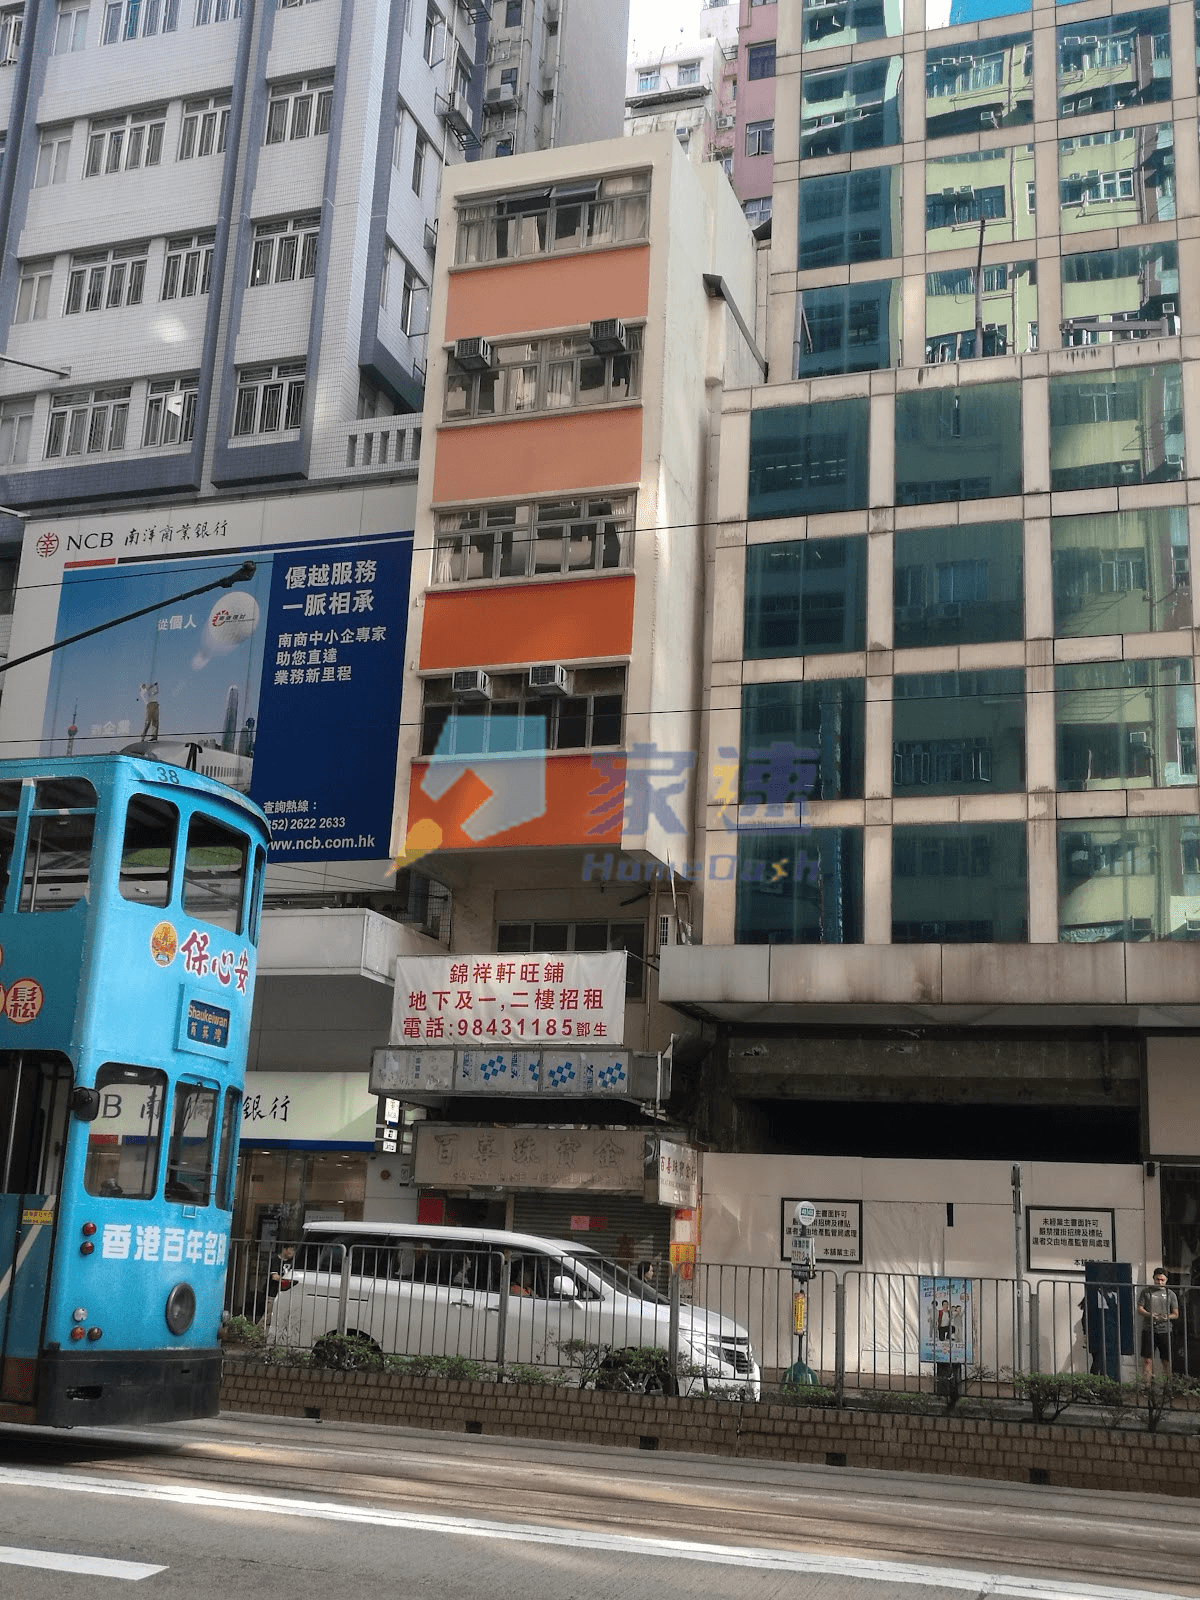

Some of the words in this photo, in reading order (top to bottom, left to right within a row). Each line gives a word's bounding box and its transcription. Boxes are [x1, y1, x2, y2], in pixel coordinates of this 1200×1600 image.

[66, 532, 114, 551] NCB
[124, 519, 229, 546] 南洋商業銀行
[285, 559, 377, 590] 優越服務
[282, 589, 375, 617] 一脈相承
[158, 614, 197, 631] 從個人
[278, 625, 387, 648] 南商中小企專家
[275, 648, 338, 667] 助您直達
[274, 665, 352, 686] 業務新里程
[157, 766, 180, 785] 38
[290, 818, 317, 830] 2622
[319, 816, 346, 829] 2633
[268, 834, 376, 851] ww.ncb.com.hk
[180, 930, 248, 995] 保心安
[450, 961, 565, 984] 錦祥軒旺鋪
[8, 986, 38, 1019] 鬆
[187, 1004, 228, 1027] Shaukeiwan
[1042, 1217, 1099, 1228] 未經業主書面許可
